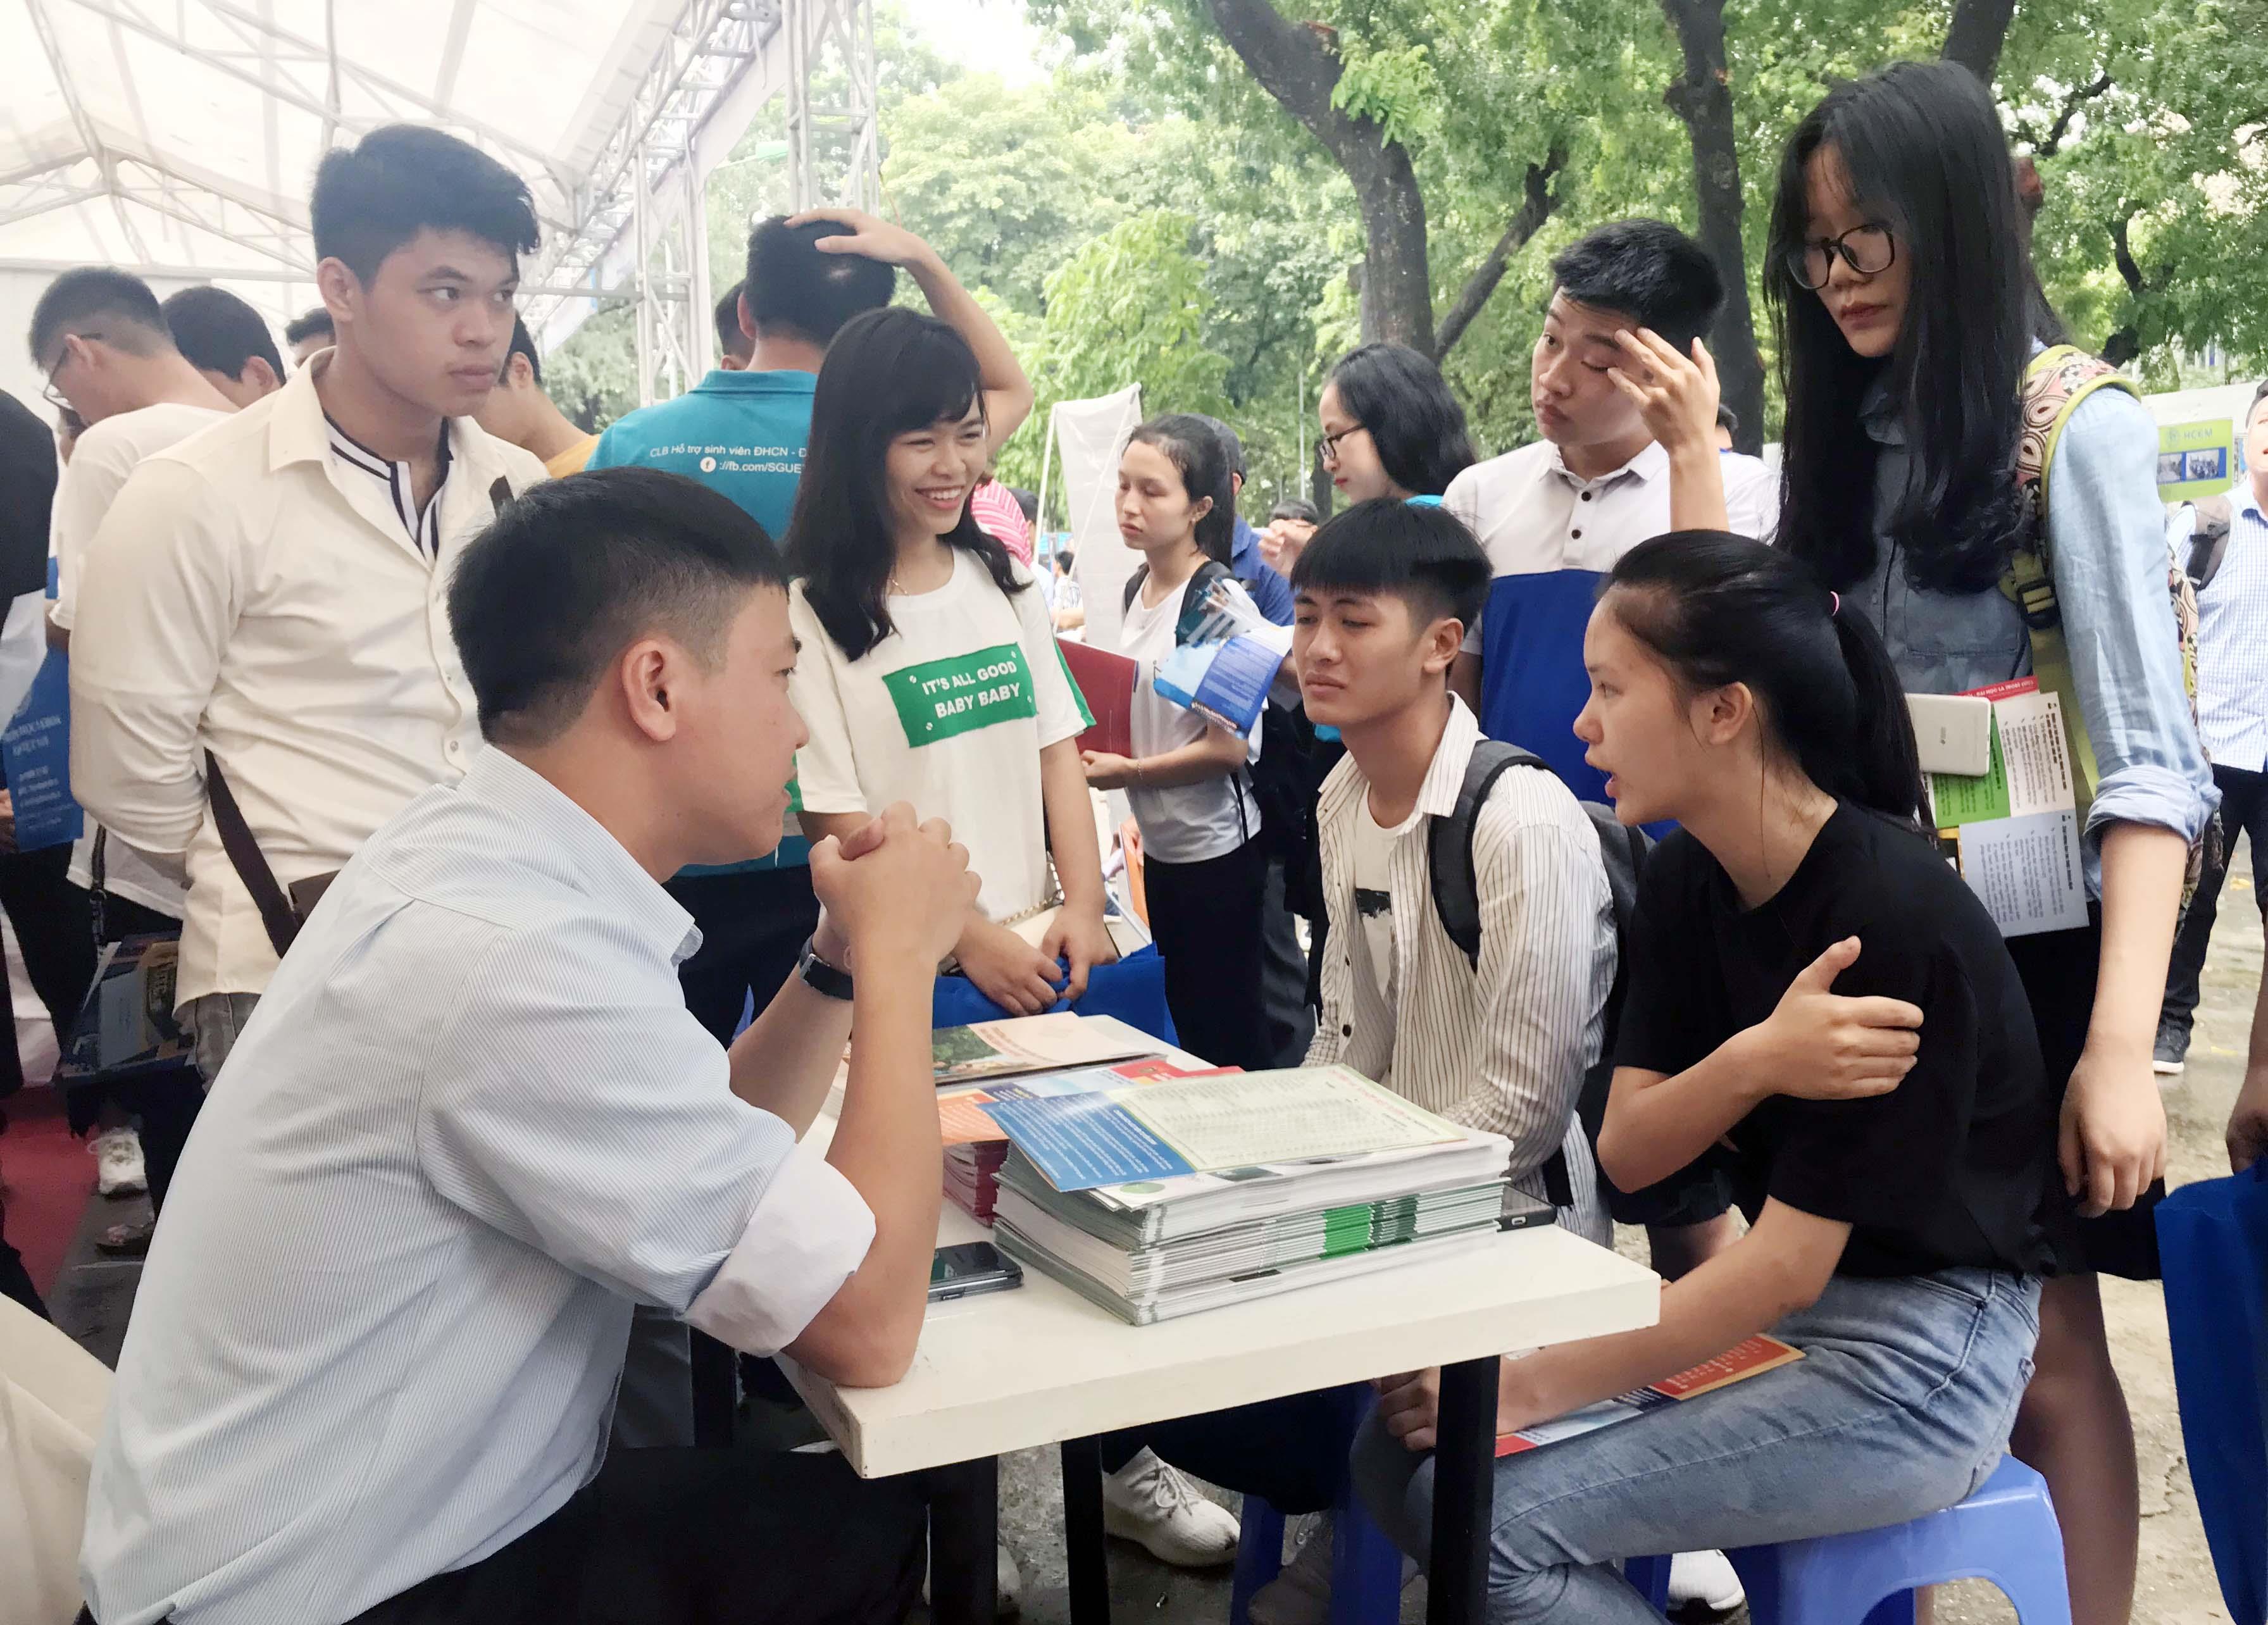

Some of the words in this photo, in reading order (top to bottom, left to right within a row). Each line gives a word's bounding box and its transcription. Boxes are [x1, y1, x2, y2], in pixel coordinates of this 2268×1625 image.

[650, 446, 669, 458] CLB
[687, 445, 702, 456] trợ
[704, 444, 726, 455] sinh
[729, 445, 751, 456] viên
[754, 447, 788, 457] ĐHCN
[720, 461, 804, 473] ://fb.com/SGUE
[922, 678, 950, 695] IT'S
[952, 673, 976, 688] ALL
[977, 661, 1017, 681] GOOD
[935, 695, 974, 718] BABY
[978, 682, 1019, 706] BABY
